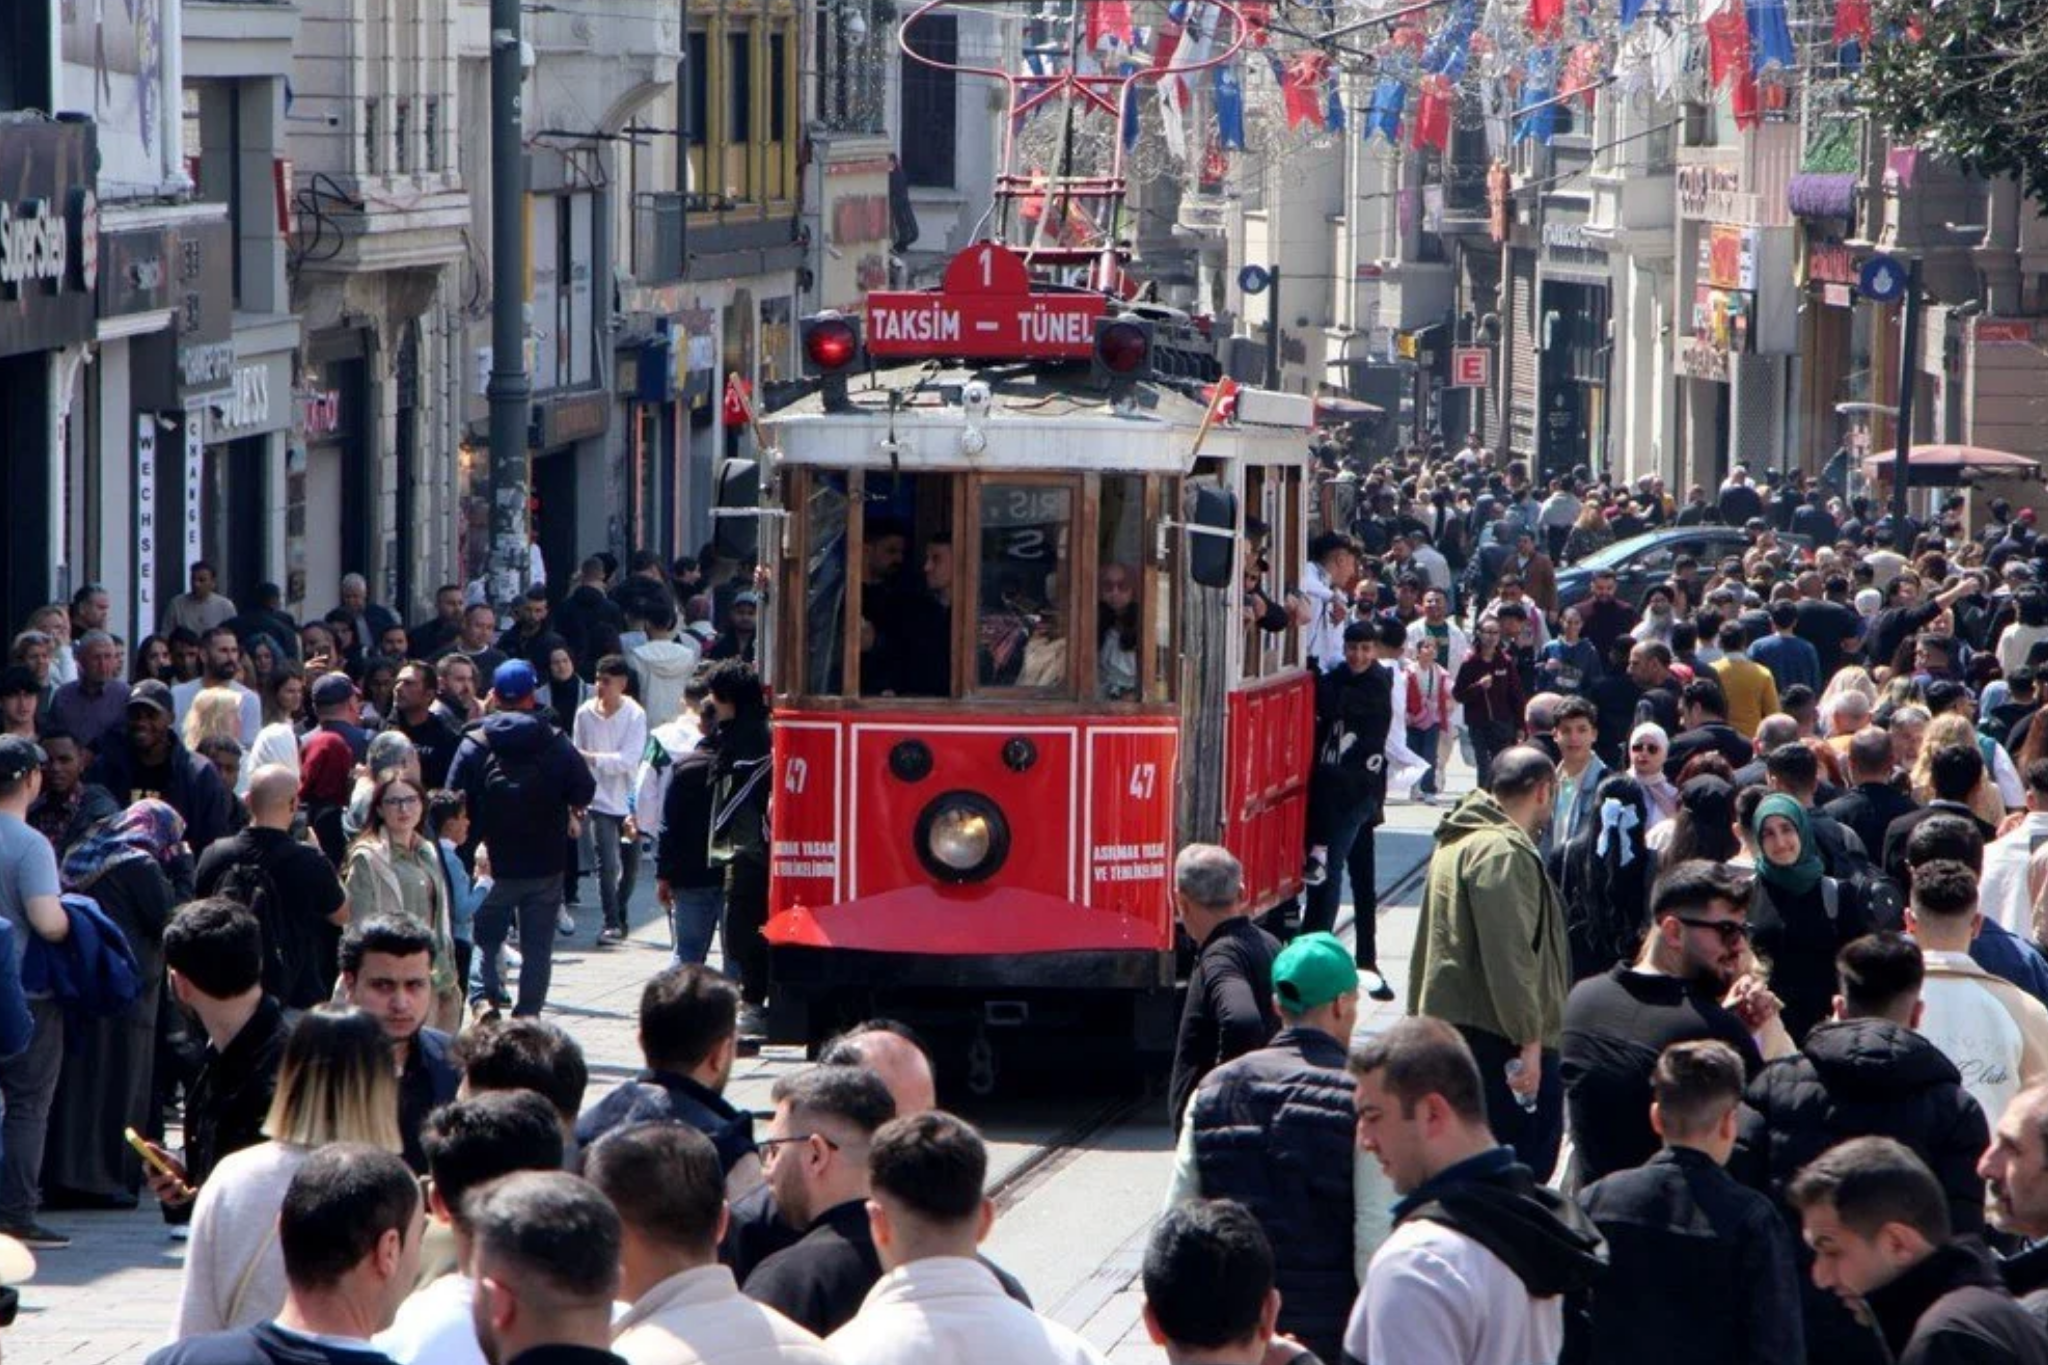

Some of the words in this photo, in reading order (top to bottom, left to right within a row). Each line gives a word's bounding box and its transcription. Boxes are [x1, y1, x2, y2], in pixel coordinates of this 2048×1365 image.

[0, 197, 66, 300] SuperStep
[979, 248, 992, 286] 1
[872, 302, 960, 340] TAKSİM
[1017, 304, 1094, 344] TÜNEL
[1464, 356, 1482, 379] E
[189, 423, 197, 544] CHANGE
[141, 436, 152, 604] WECHSEL
[785, 757, 807, 794] 47
[1129, 763, 1156, 799] 47
